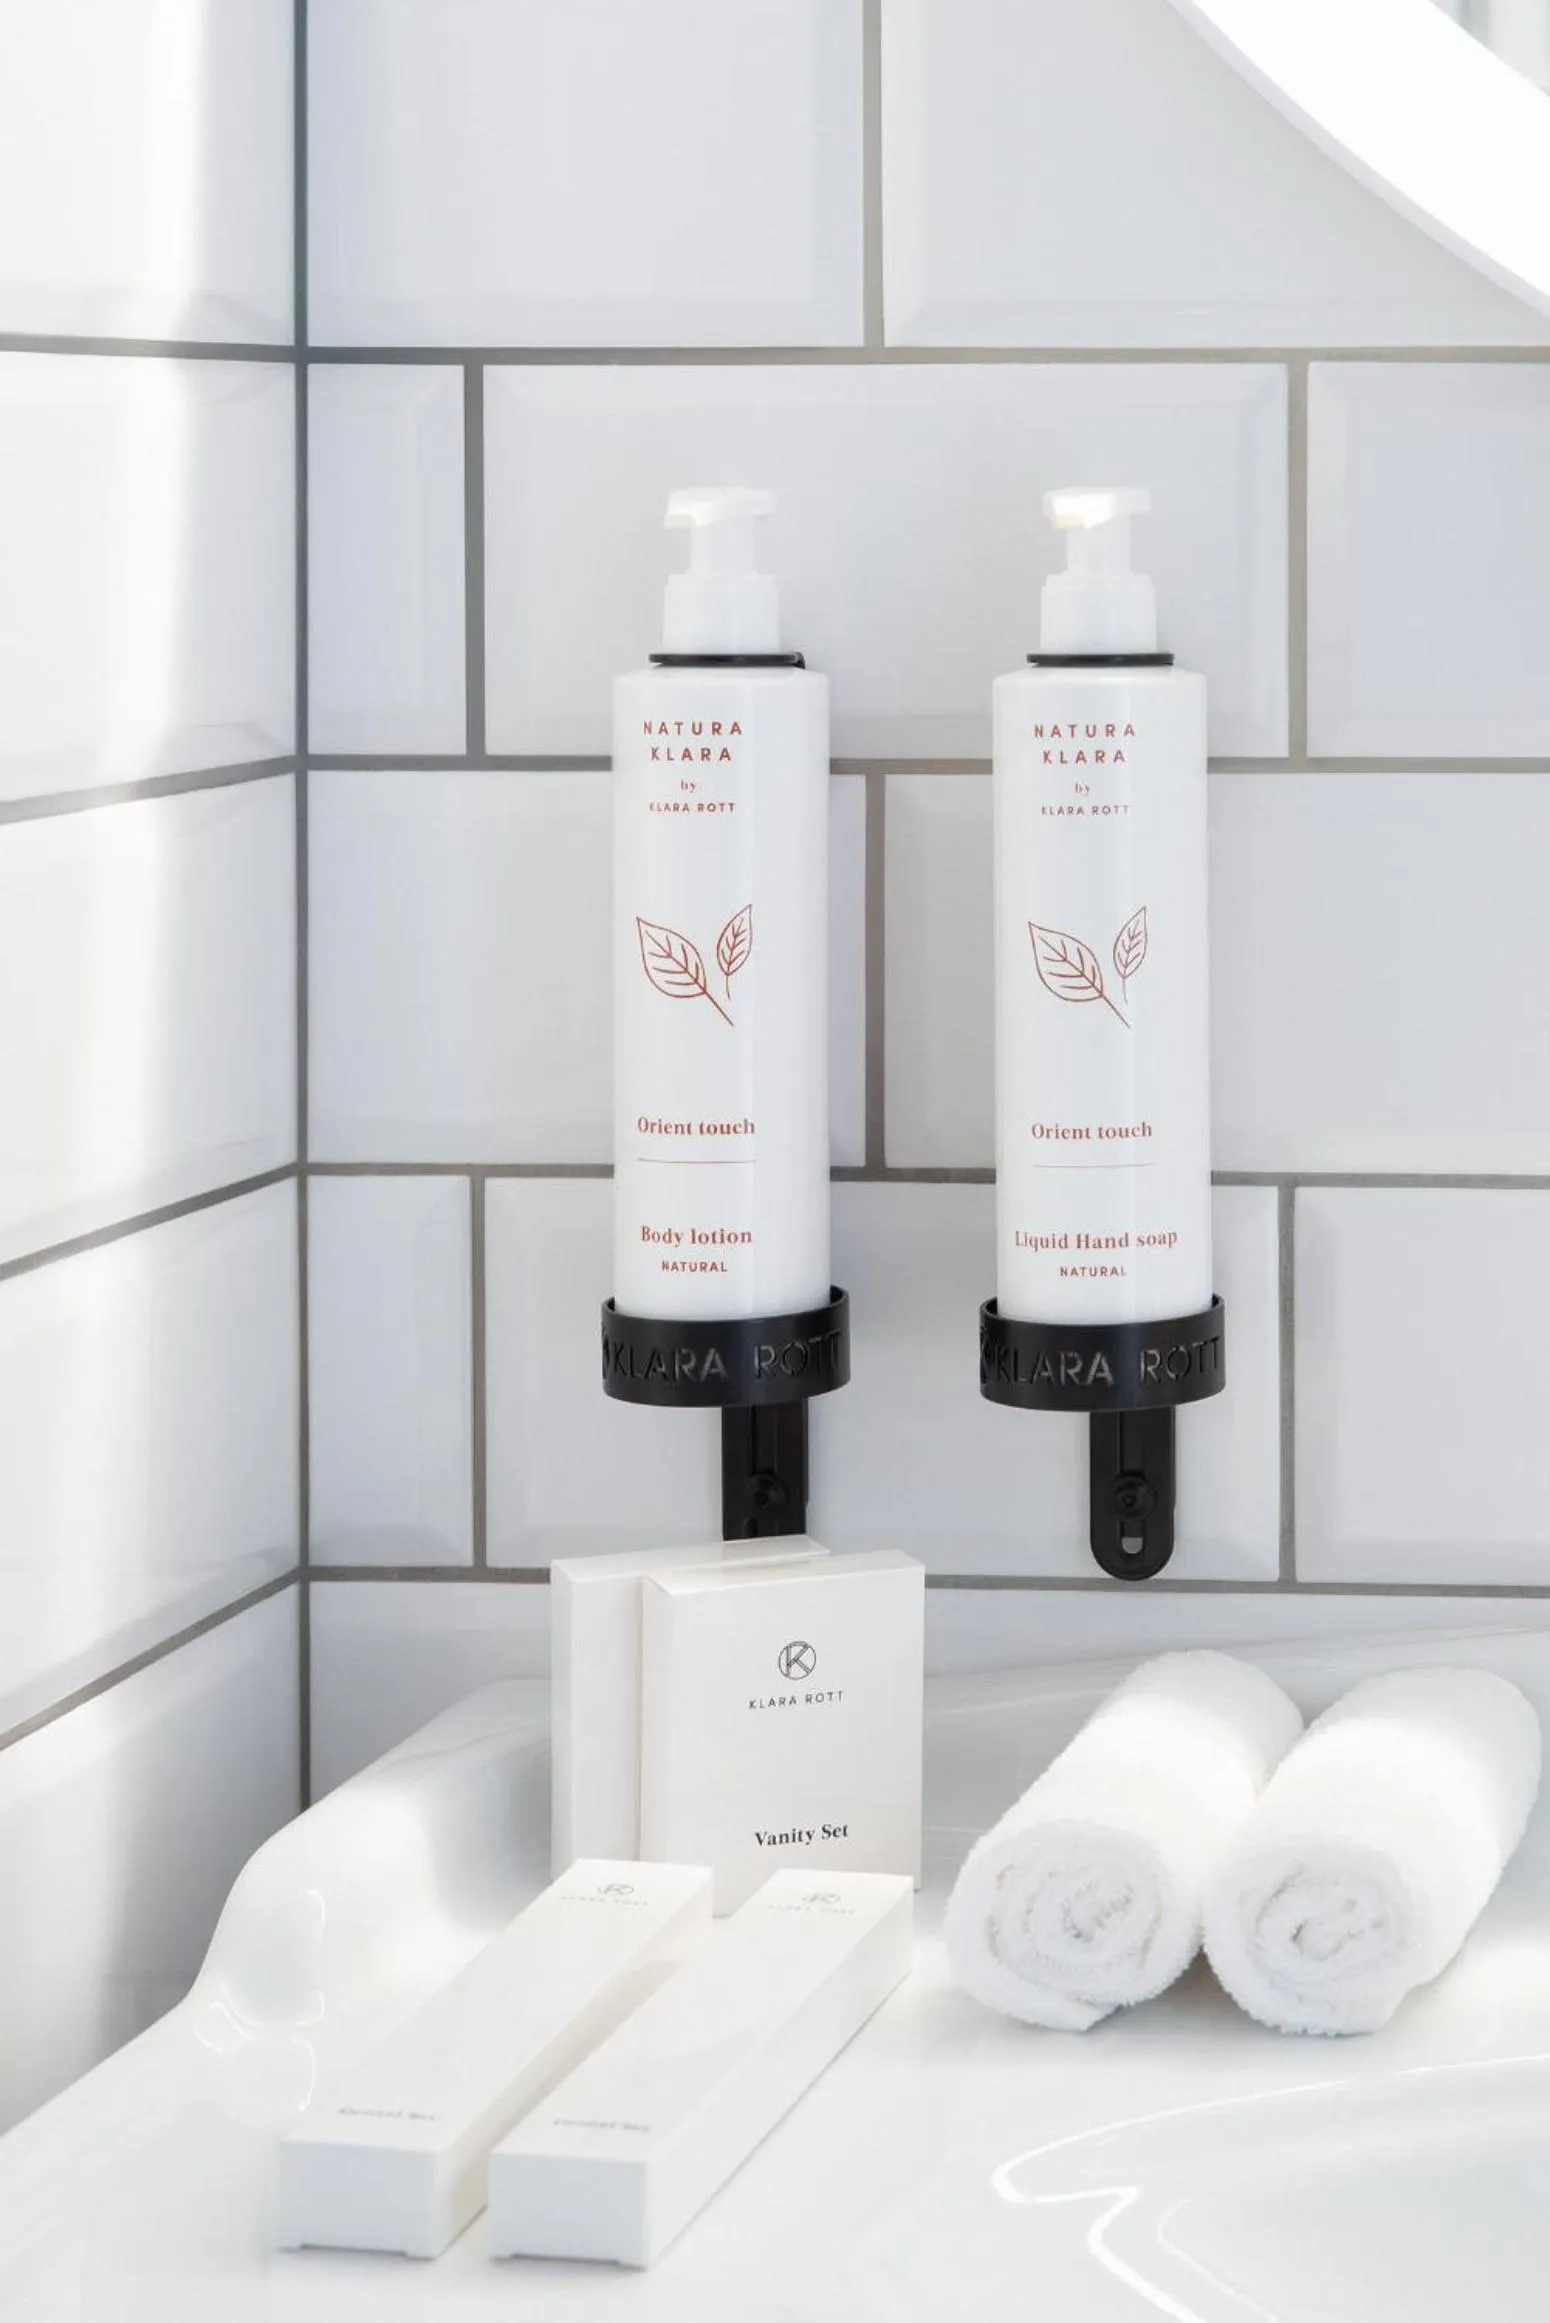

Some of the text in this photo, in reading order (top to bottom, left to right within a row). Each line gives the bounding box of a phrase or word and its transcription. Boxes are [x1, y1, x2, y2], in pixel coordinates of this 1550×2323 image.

[642, 720, 742, 736] NATURA
[1033, 723, 1136, 738] NATURA
[650, 747, 731, 761] KLARA
[1041, 749, 1126, 764] KLARA
[680, 779, 697, 793] by
[1074, 783, 1091, 796] by
[648, 802, 736, 813] KLARA ROTT
[1041, 804, 1130, 816] KLARA ROTT
[637, 1116, 756, 1136] Orient touch
[1031, 1120, 1153, 1140] Orient touch
[641, 1225, 752, 1248] Body lotion
[1014, 1229, 1178, 1252] Liquid Hand soap
[661, 1259, 728, 1273] NATURAL
[1060, 1265, 1127, 1278] NATURAL
[612, 1341, 730, 1383] KLARA
[752, 1328, 842, 1380] ROTT
[993, 1345, 1116, 1388] KLARA
[1138, 1335, 1222, 1384] ROTT
[748, 1690, 844, 1710] KLARA ROTT
[755, 1823, 849, 1846] Vanity Set
